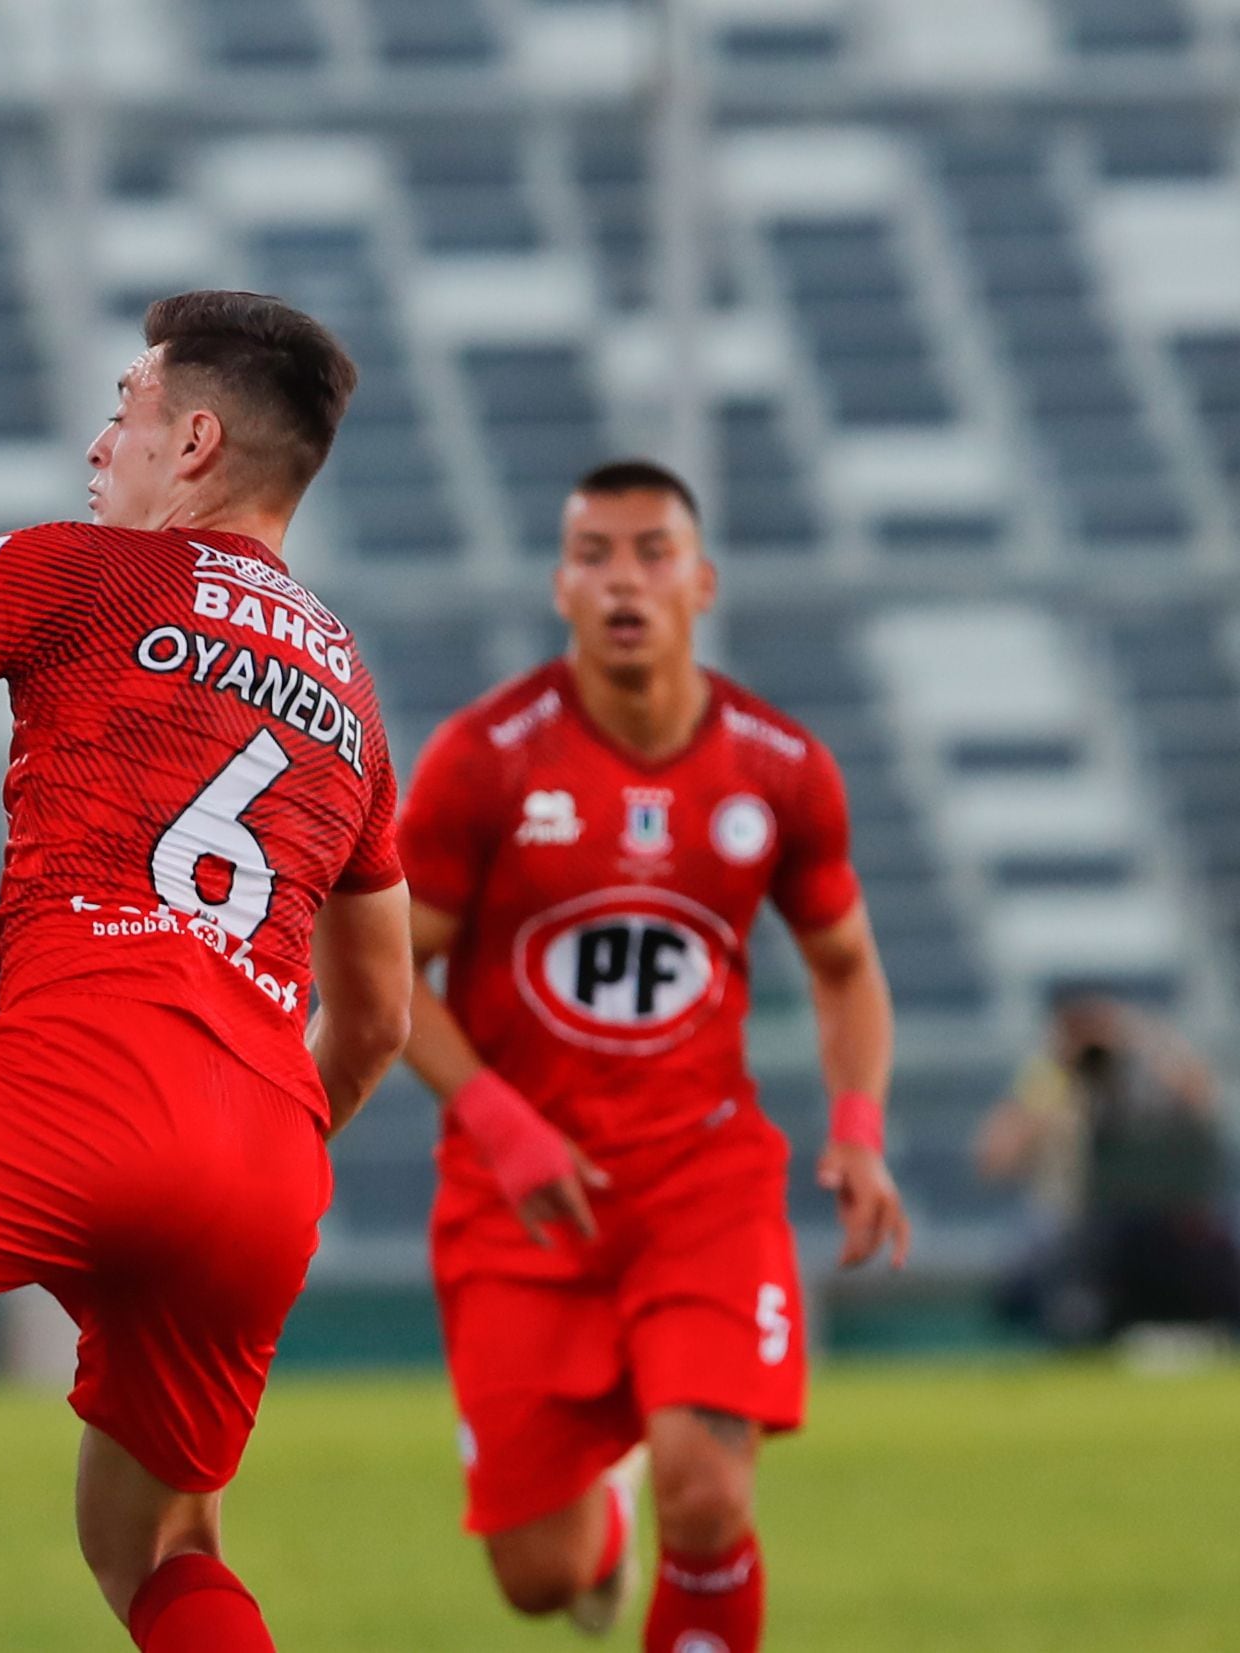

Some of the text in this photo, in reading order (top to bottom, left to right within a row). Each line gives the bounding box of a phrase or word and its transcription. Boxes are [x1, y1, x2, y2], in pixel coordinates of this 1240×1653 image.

[192, 581, 352, 684] BAHCO
[136, 625, 364, 778] OYANEDEL
[148, 724, 294, 943] 6
[575, 924, 687, 1018] PF
[755, 1282, 791, 1366] 5
